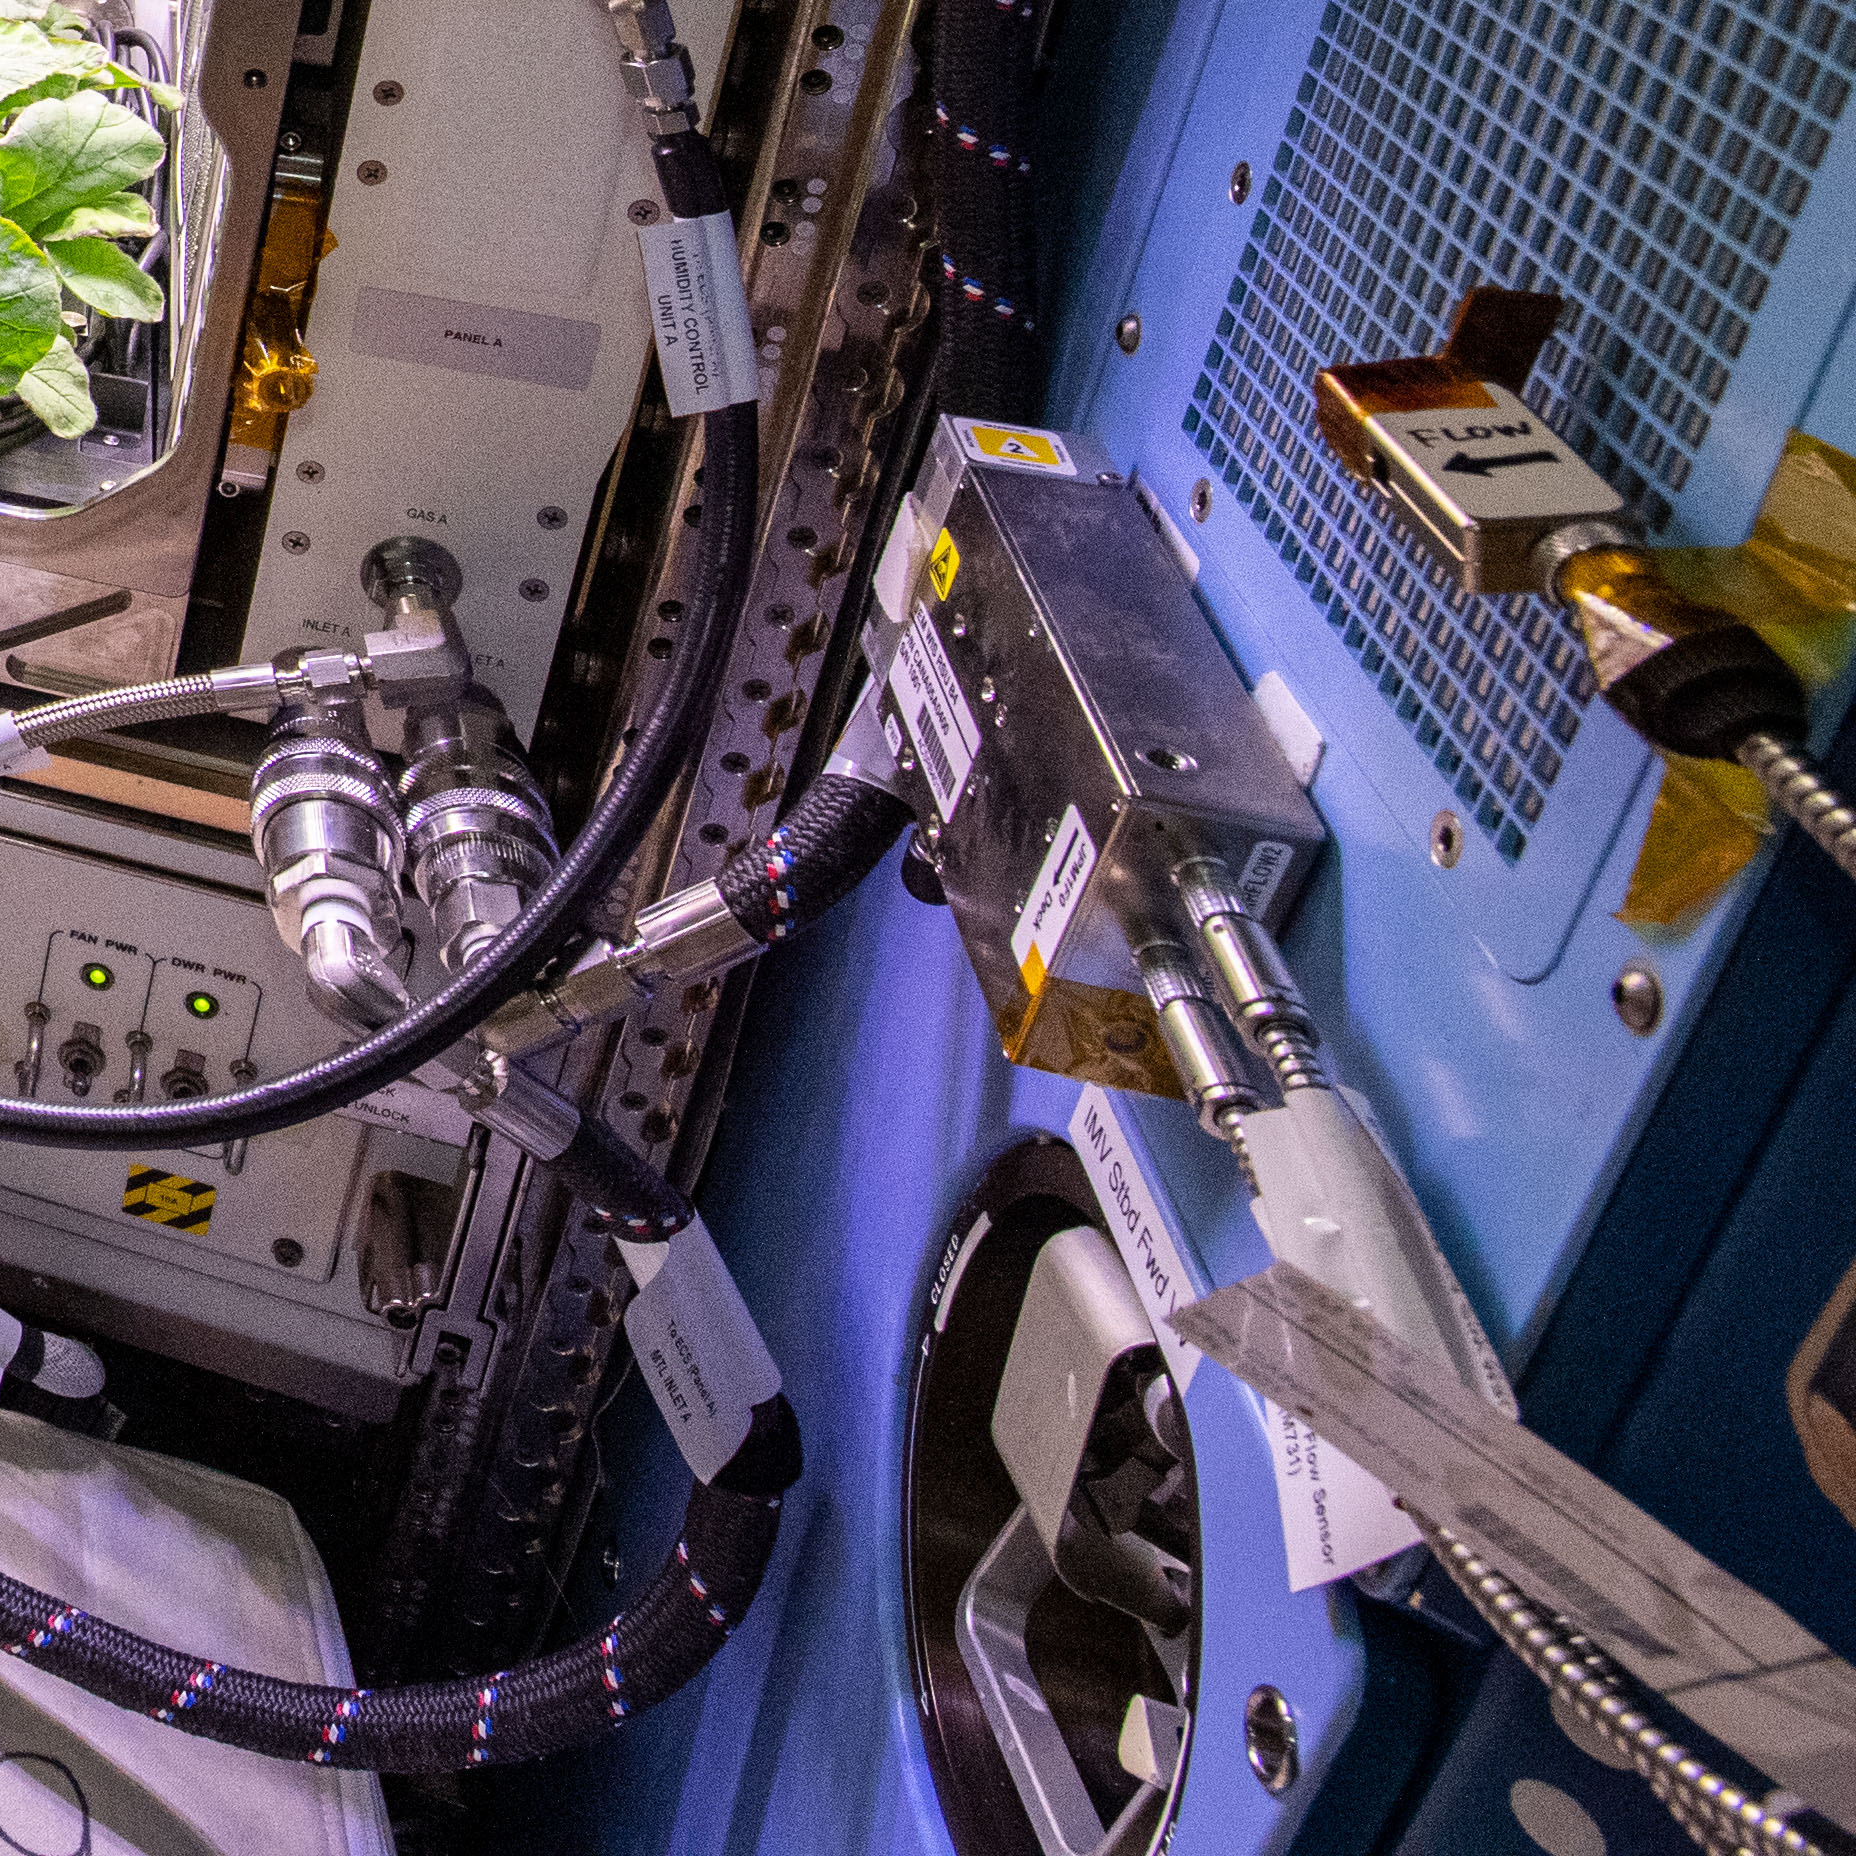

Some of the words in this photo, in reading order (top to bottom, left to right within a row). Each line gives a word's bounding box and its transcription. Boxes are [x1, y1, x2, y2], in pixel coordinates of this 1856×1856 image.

[670, 238, 695, 313] HUMIDITY
[656, 294, 677, 331] UNIT
[443, 329, 490, 346] PANEL
[682, 317, 710, 396] CONTROL
[1408, 419, 1532, 450] FLOW
[406, 508, 436, 523] GAS
[301, 619, 341, 635] INLET
[69, 929, 99, 945] FAN
[104, 939, 139, 956] PWR
[170, 956, 207, 974] DWR
[212, 967, 248, 985] PWR
[353, 1100, 411, 1125] UNLOCK
[1083, 1104, 1113, 1165] IMV
[1108, 1163, 1142, 1234] Stbd
[1136, 1226, 1169, 1299] Fwd
[930, 1233, 960, 1306] CLOSED
[651, 1347, 666, 1379] MTL
[664, 1372, 687, 1410] INLET
[674, 1335, 694, 1365] ECS
[686, 1361, 711, 1401] (Panel
[1303, 1425, 1321, 1482] Flow
[1311, 1487, 1335, 1566] Sensor
